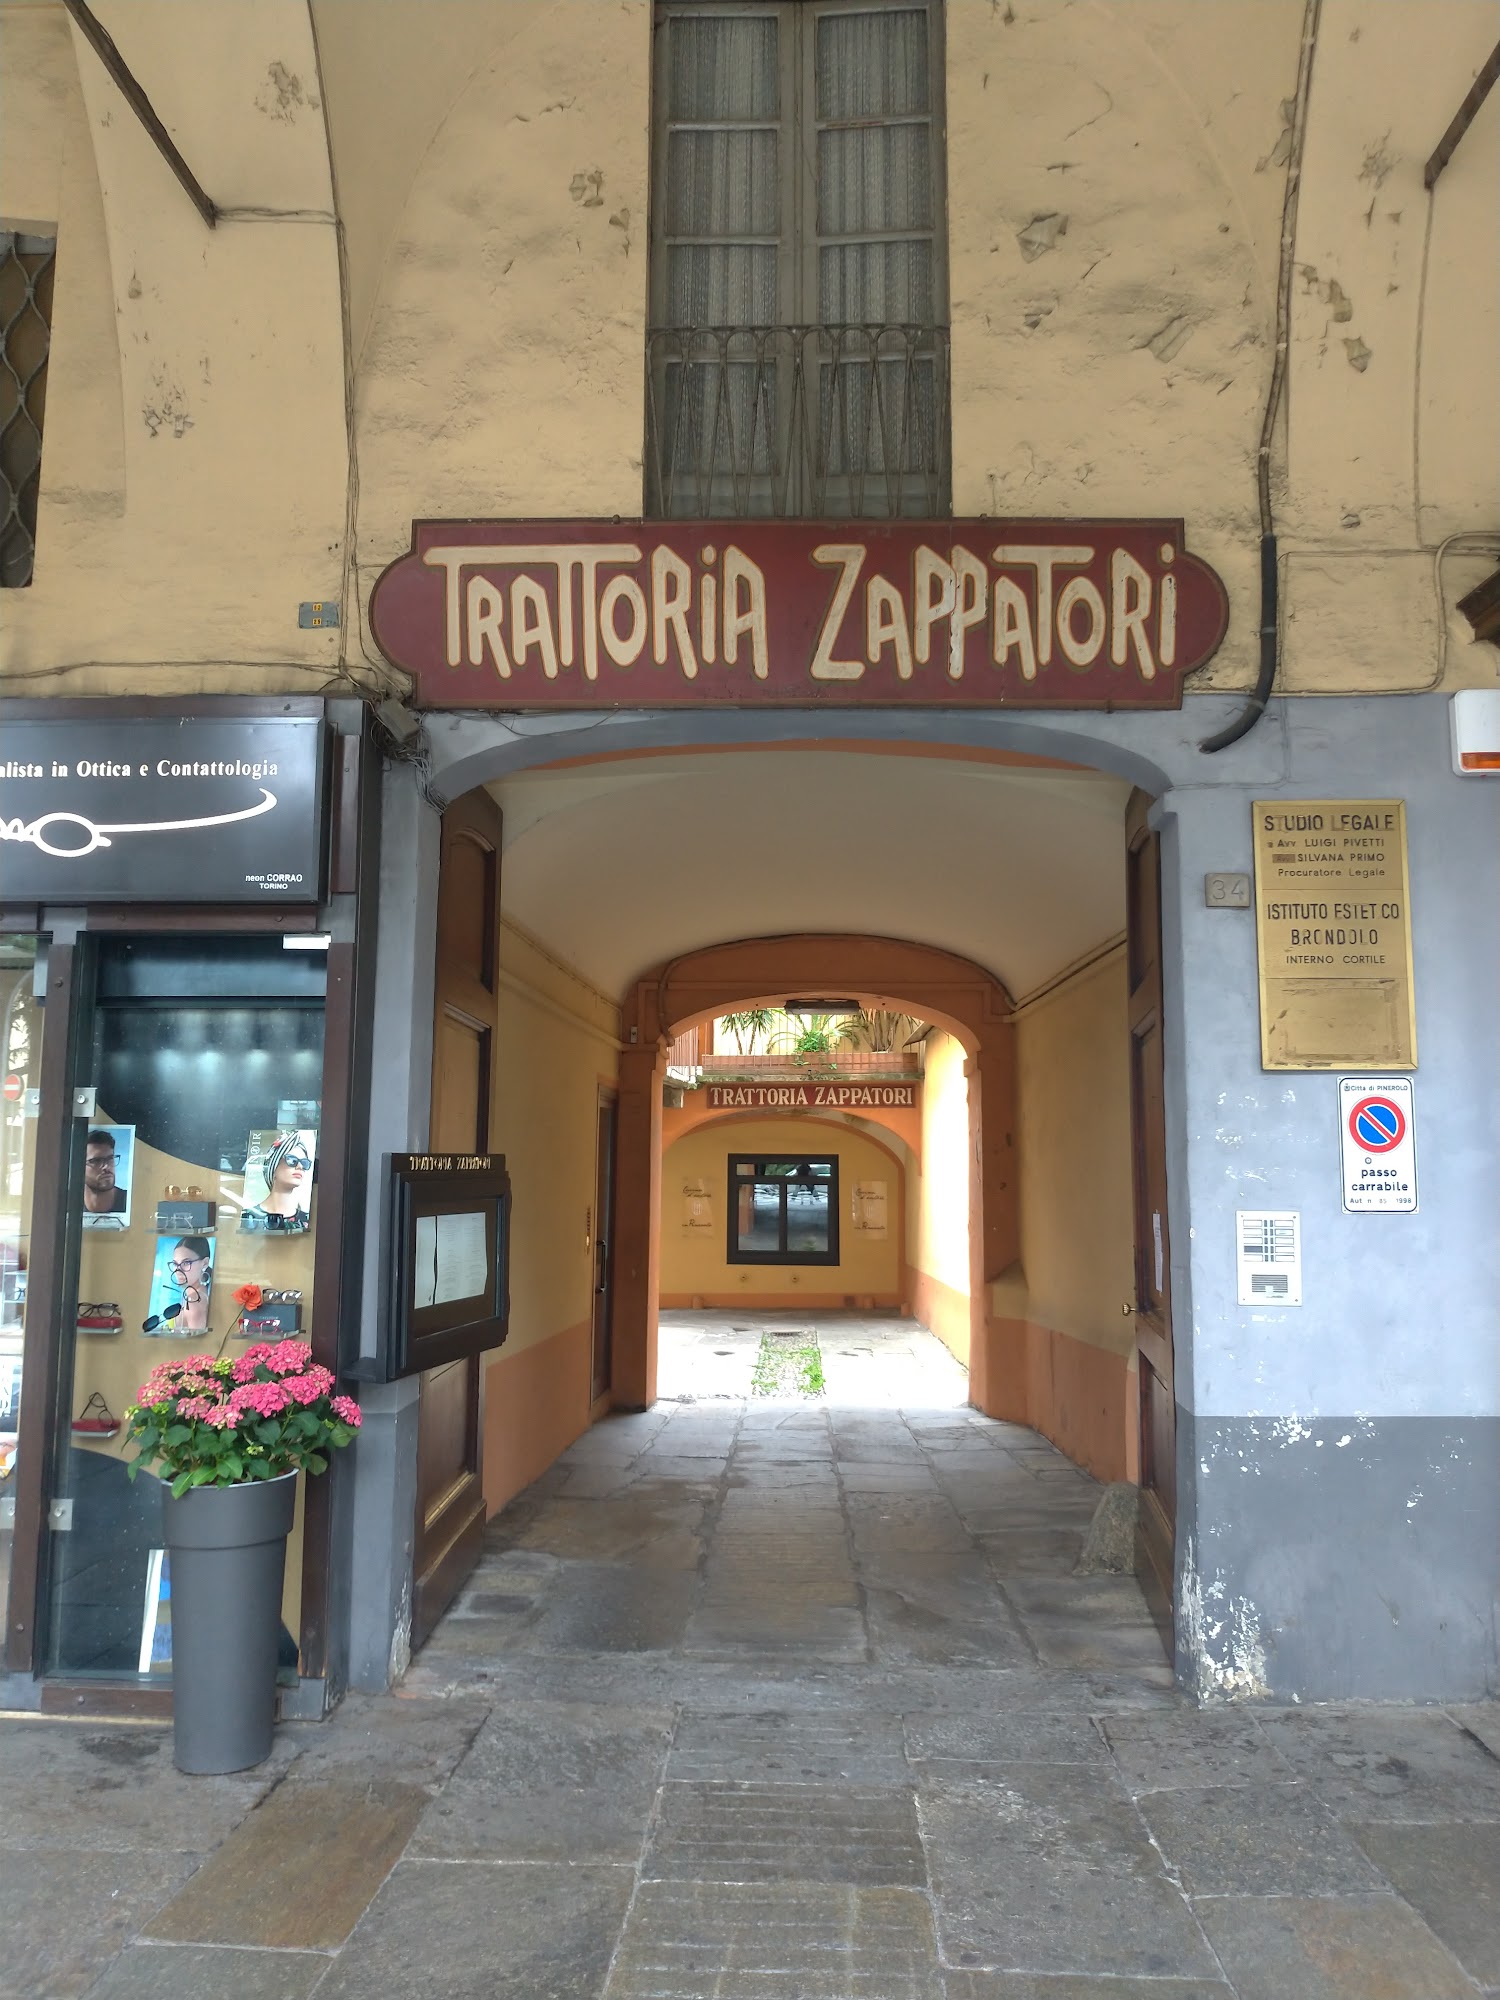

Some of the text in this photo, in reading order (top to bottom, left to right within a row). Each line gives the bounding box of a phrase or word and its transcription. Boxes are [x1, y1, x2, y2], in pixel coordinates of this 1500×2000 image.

[51, 760, 69, 777] in
[76, 760, 131, 778] Ottica
[139, 764, 149, 777] e
[156, 760, 278, 780] Contattologia
[1264, 814, 1395, 832] STUDIO LEGALE
[1304, 838, 1337, 848] LUIGI
[1343, 838, 1385, 847] PIVETTI
[1297, 853, 1344, 862] SILVANA
[1350, 853, 1385, 862] PRIMO
[266, 873, 303, 882] CORRAO
[1278, 868, 1386, 879] Procuratore Legale
[259, 882, 289, 890] TORINO
[1212, 879, 1244, 900] 34
[1267, 903, 1328, 920] ISTITUTO
[1290, 929, 1378, 945] BRONDOLO
[1286, 955, 1386, 964] INTERNO CORTILE
[710, 1086, 913, 1105] TRATTORIA ZAPPATORI
[1361, 1169, 1397, 1179] passo
[1351, 1182, 1408, 1191] carrabile
